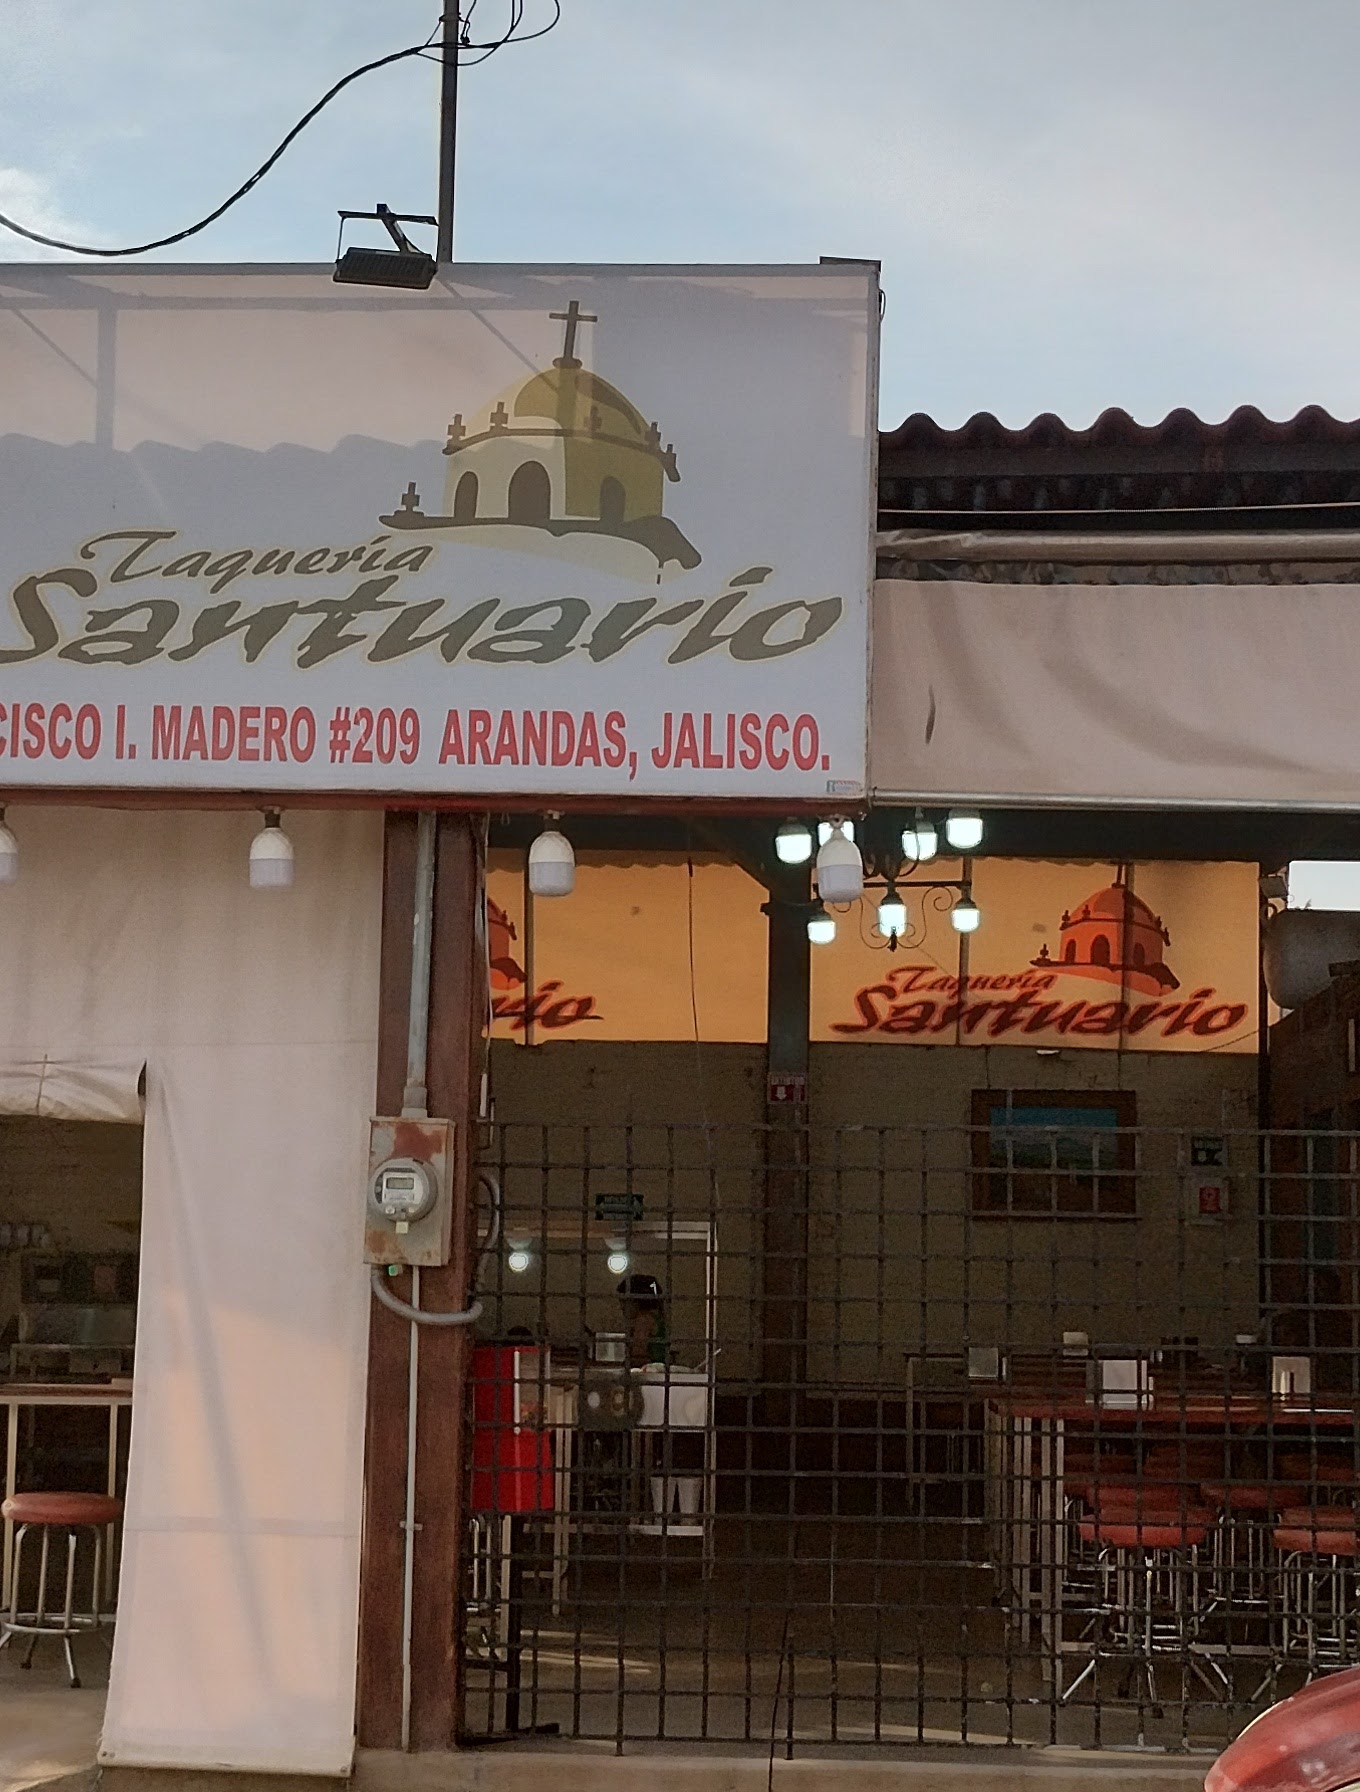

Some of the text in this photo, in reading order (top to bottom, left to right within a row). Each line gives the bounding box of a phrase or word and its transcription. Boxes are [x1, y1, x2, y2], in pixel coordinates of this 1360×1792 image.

[80, 529, 434, 586] Taquería
[115, 704, 137, 760] I.
[151, 704, 317, 763] MADERO
[328, 706, 420, 765] #209
[439, 708, 639, 780] ARANDAS,
[651, 711, 831, 772] JALISCO.
[830, 985, 1251, 1038] Santuario
